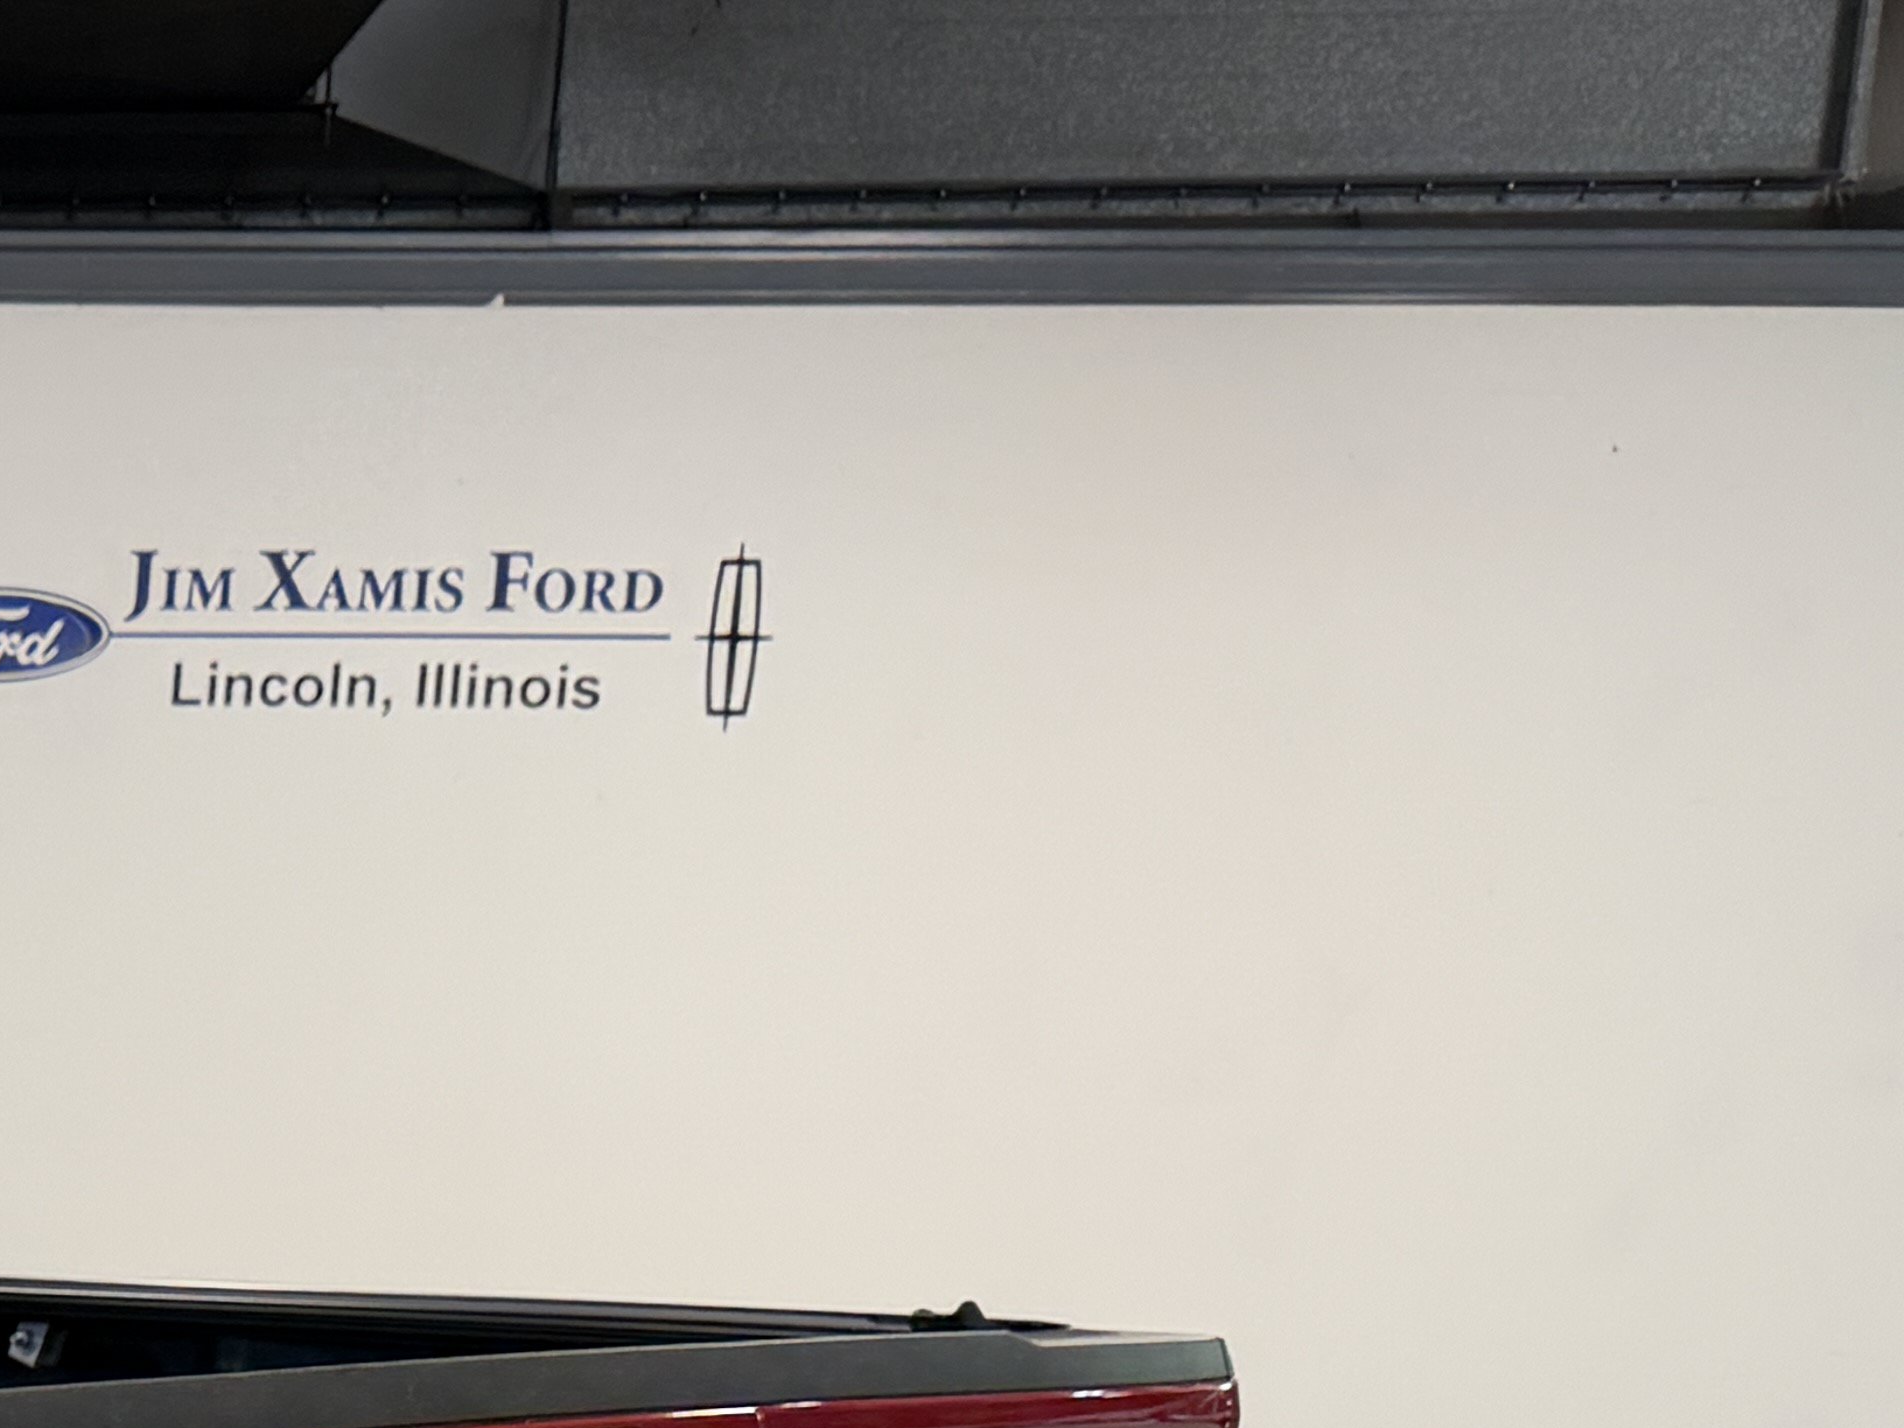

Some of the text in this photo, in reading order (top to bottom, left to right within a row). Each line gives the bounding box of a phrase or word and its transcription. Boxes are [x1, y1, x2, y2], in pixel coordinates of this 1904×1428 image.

[257, 550, 464, 614] XAMIS
[489, 550, 665, 613] FORD
[169, 661, 602, 716] Lincoln, Illinois
